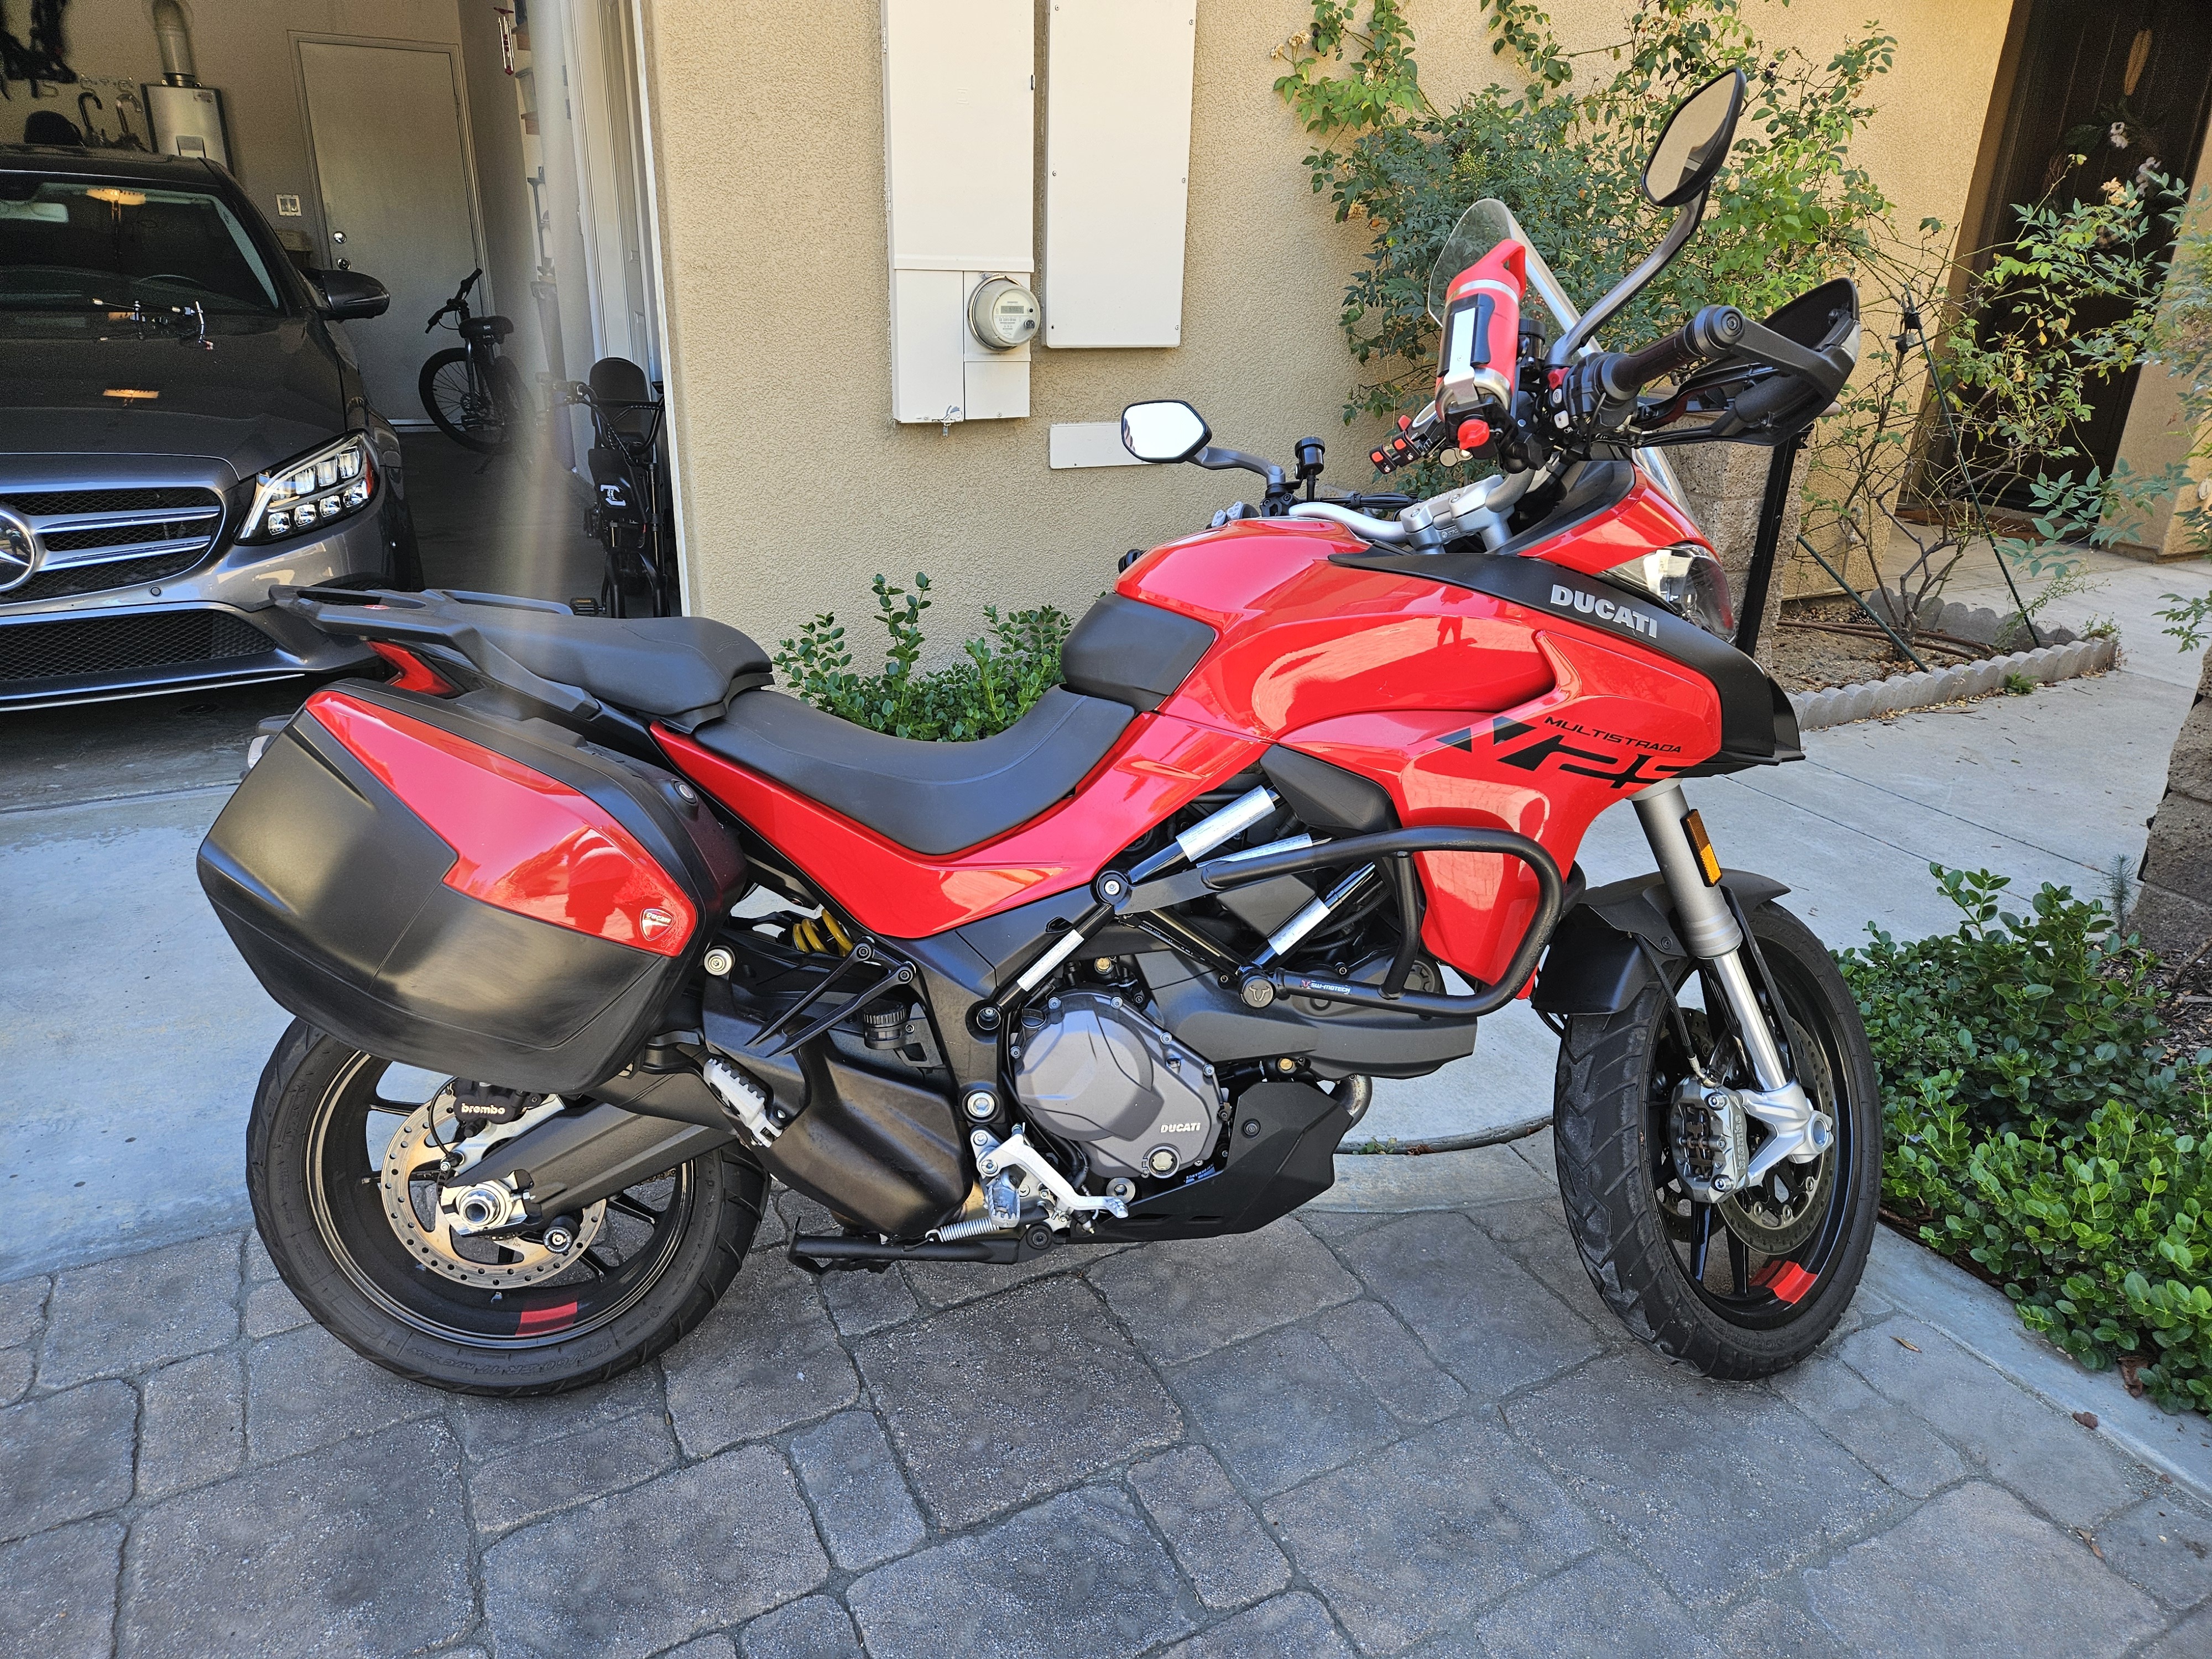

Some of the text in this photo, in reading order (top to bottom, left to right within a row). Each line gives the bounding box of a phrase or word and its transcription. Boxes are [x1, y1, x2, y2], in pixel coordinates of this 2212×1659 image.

[1551, 584, 1657, 639] DUCATI
[1545, 716, 1682, 753] MULTISTRADA
[646, 912, 672, 923] DUCATI
[1310, 982, 1351, 993] SW-MOTECH
[461, 1102, 505, 1115] brembo
[1160, 1122, 1201, 1133] DUCATI
